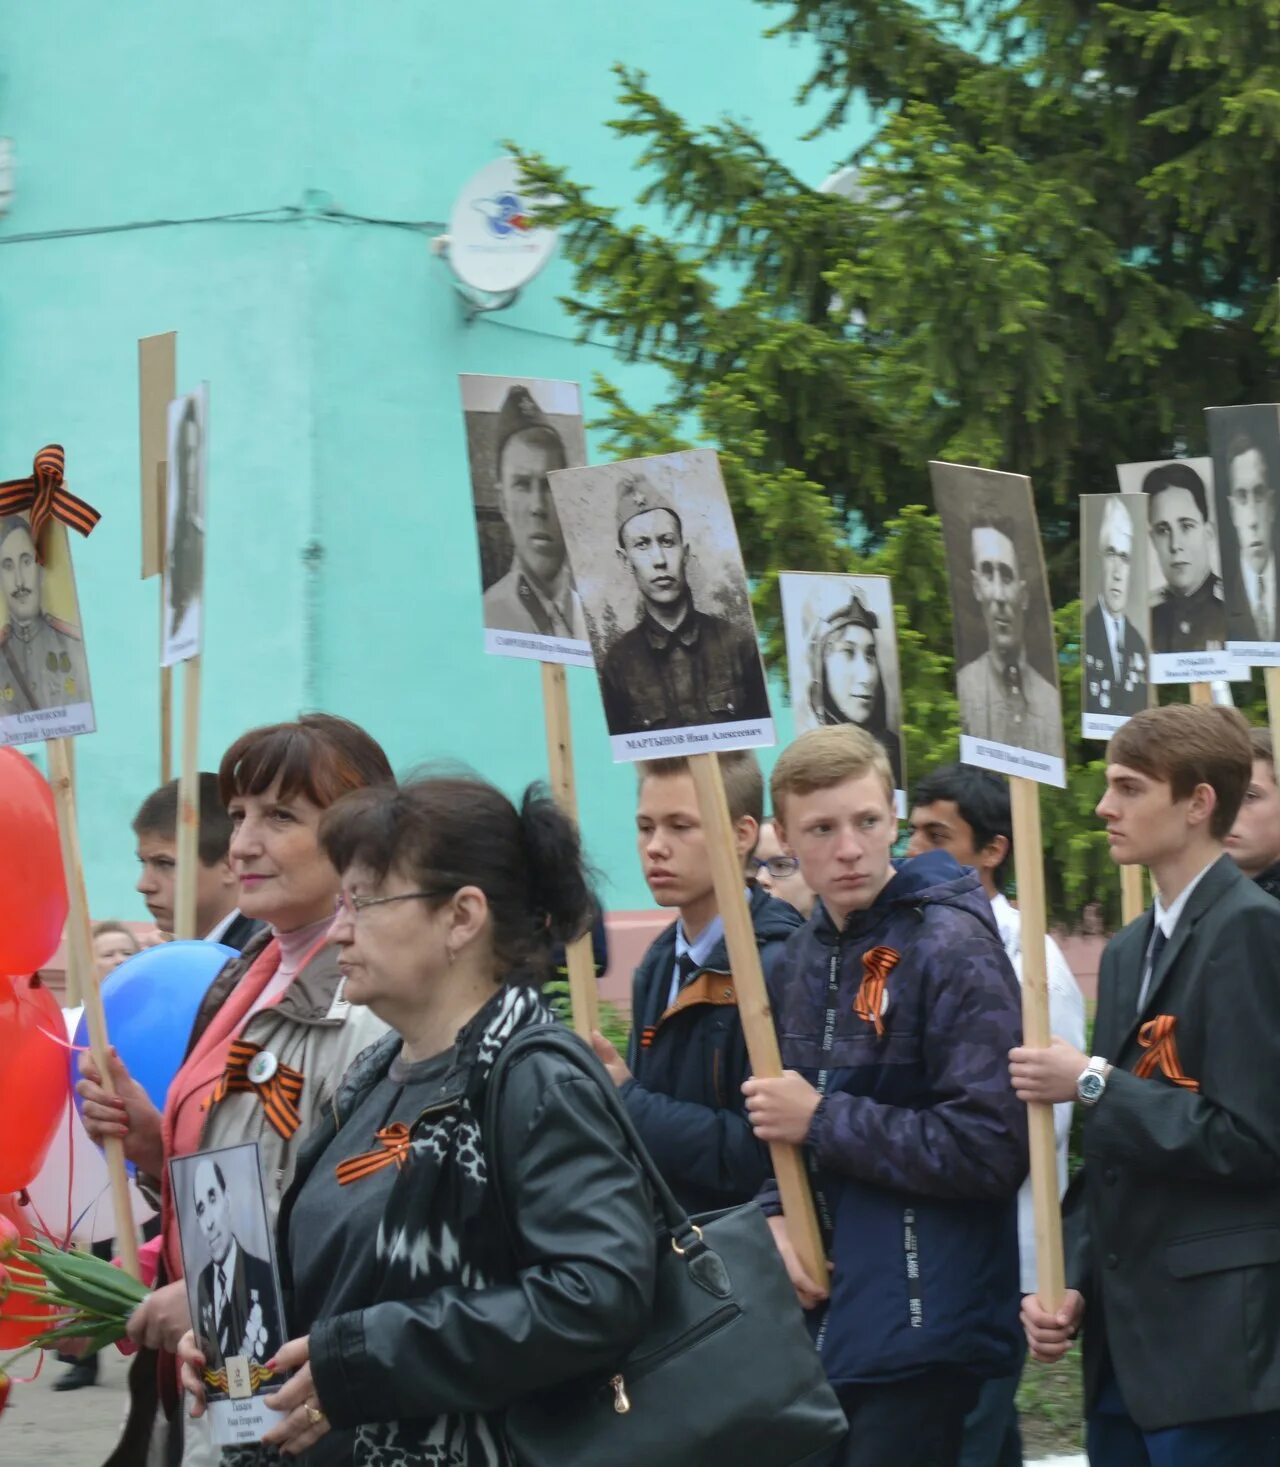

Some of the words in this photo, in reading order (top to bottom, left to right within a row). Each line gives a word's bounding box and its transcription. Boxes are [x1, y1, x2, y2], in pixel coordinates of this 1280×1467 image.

[626, 734, 685, 749] МАРТЫНОВ
[686, 732, 709, 744] Иван
[712, 727, 762, 741] Алексеевич
